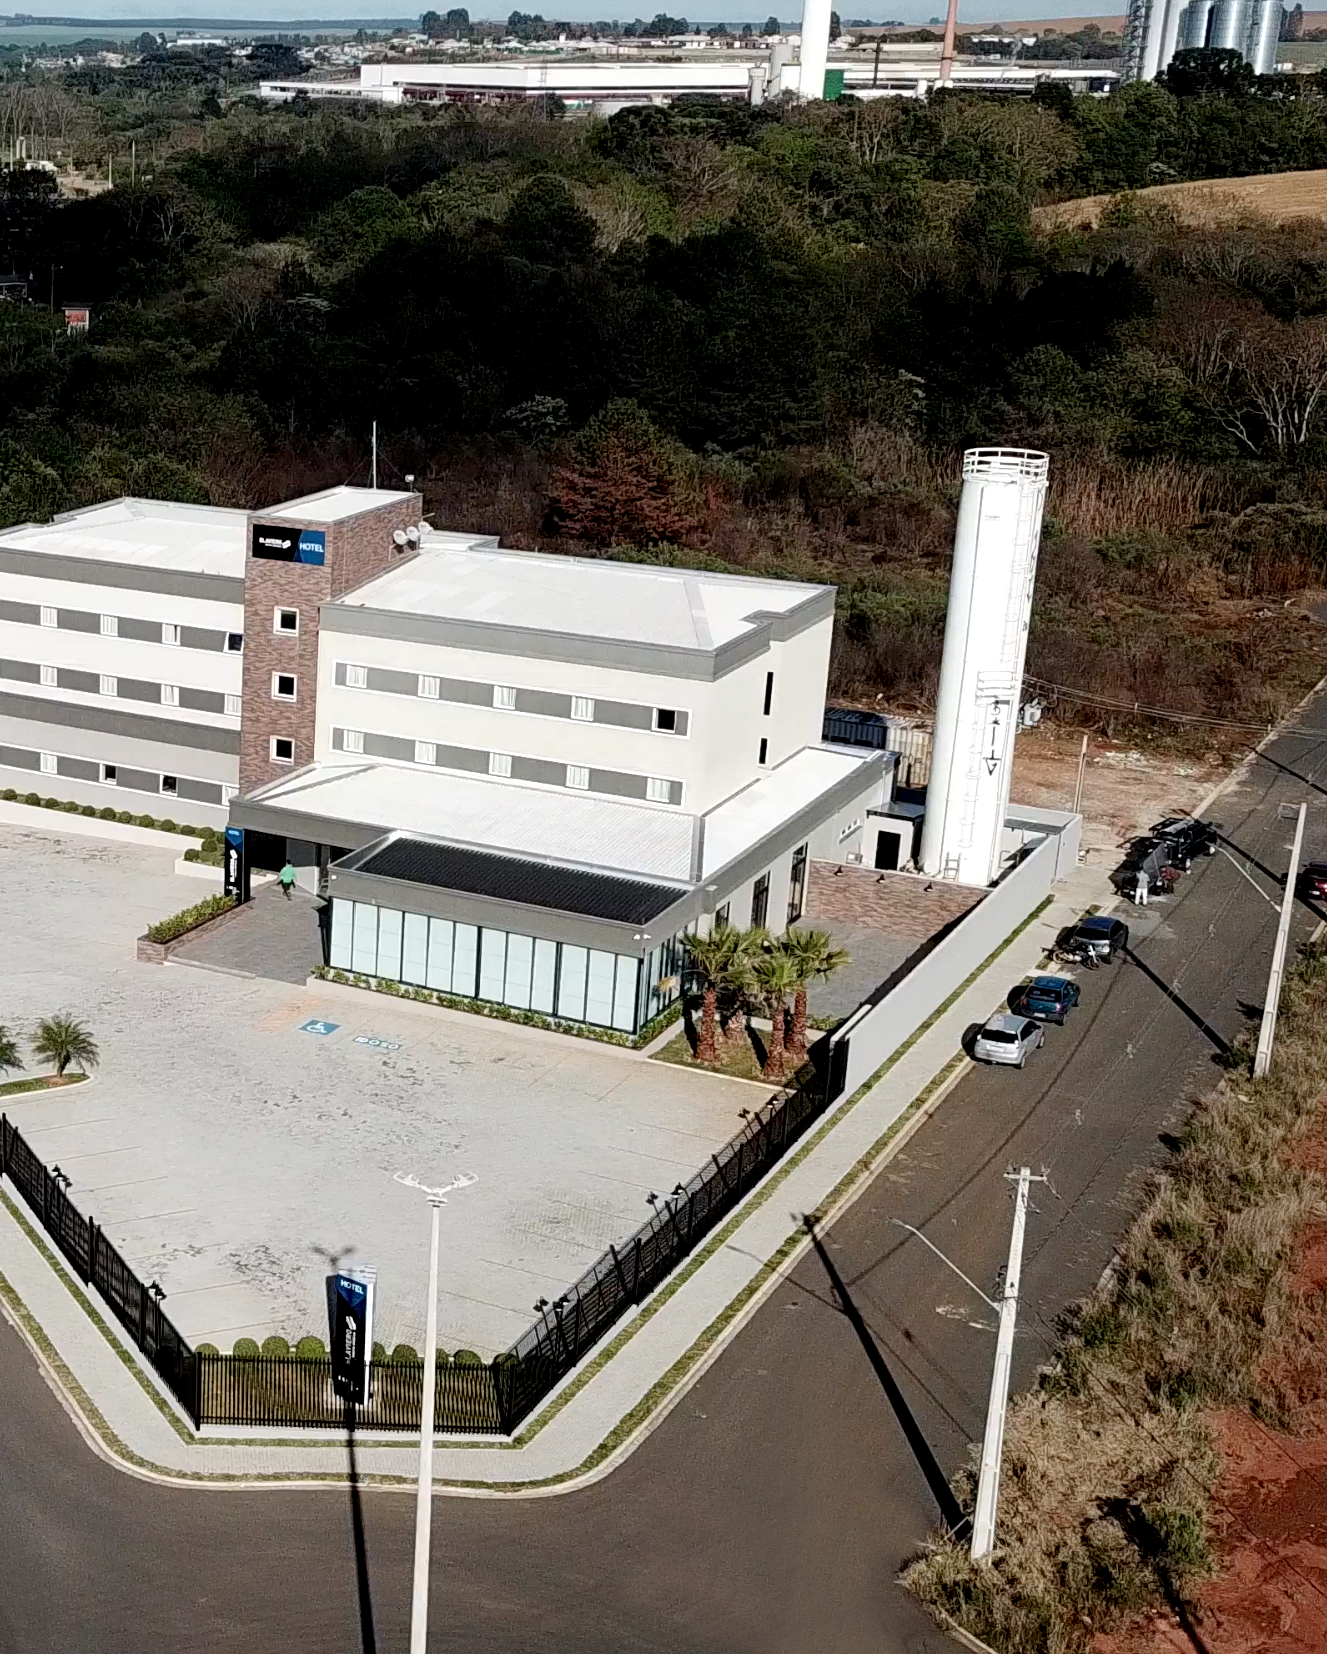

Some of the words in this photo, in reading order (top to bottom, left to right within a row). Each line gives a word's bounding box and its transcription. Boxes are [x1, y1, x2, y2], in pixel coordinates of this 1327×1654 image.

[300, 542, 324, 552] HOTEL
[355, 1036, 399, 1050] IDOSO
[340, 1279, 364, 1294] HOTEL
